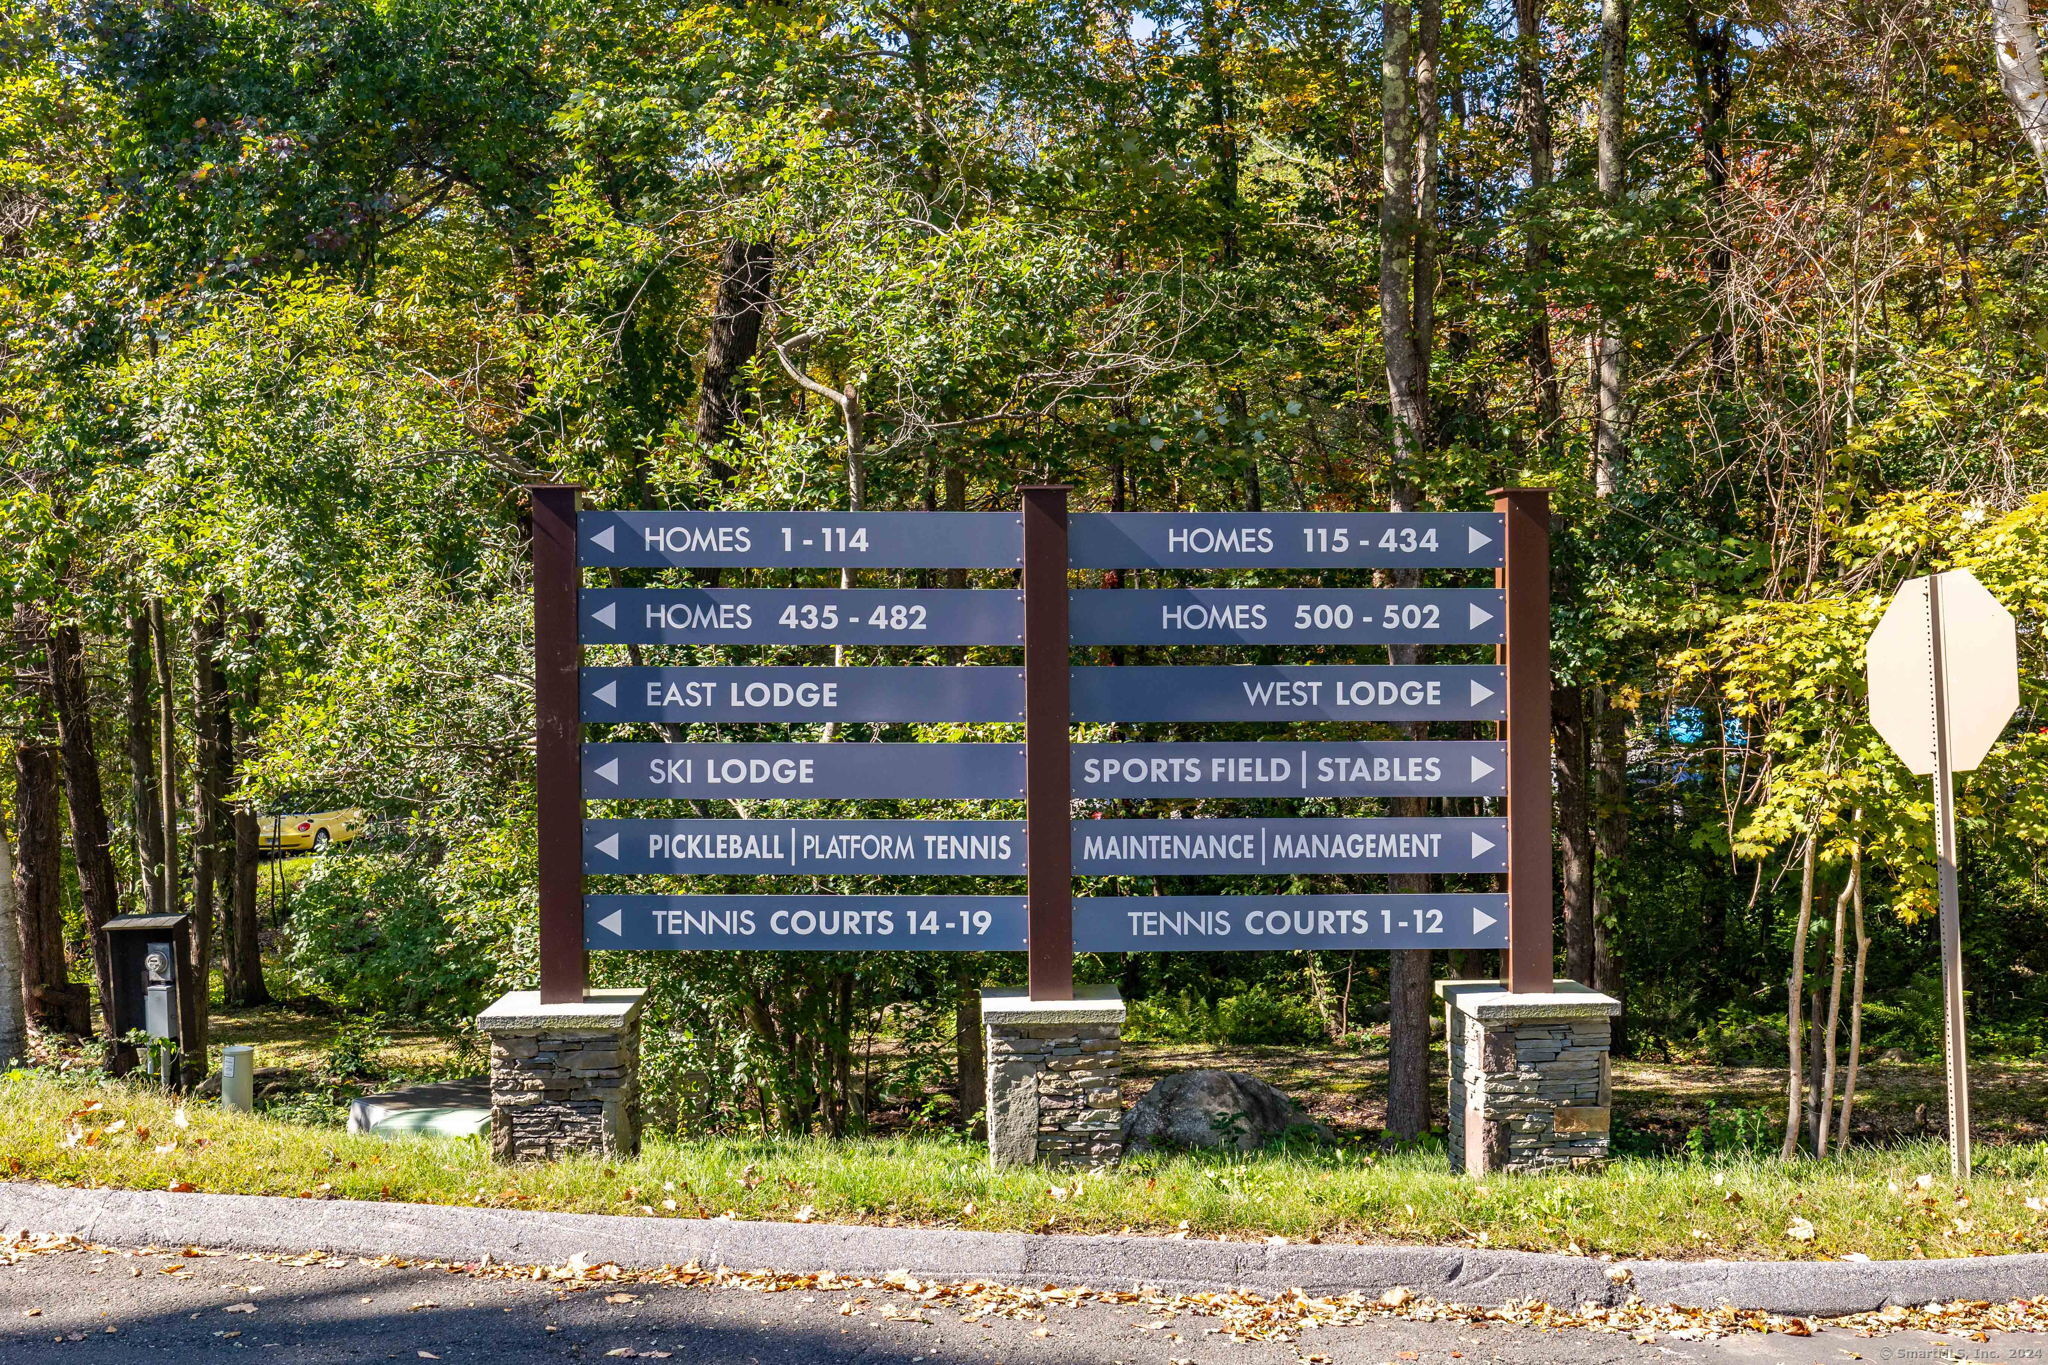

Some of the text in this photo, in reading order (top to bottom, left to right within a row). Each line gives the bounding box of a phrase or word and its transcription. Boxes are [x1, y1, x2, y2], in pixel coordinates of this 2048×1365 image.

[645, 527, 751, 552] HOMES
[782, 528, 791, 552] 1
[822, 528, 869, 552] 114
[1169, 528, 1273, 553] HOMES
[1304, 528, 1349, 552] 115
[1378, 528, 1438, 552] 434
[646, 604, 752, 629] HOMES
[779, 605, 838, 629] 435
[868, 605, 926, 629] 482
[1163, 605, 1267, 629] HOMES
[1294, 605, 1353, 629] 500
[1383, 605, 1439, 629] 502
[647, 682, 837, 707] EAST LODGE
[1243, 681, 1440, 706] WEST LODGE
[649, 759, 813, 783] SKI LODGE
[1084, 757, 1441, 783] SPORTS FIELD STABLES
[649, 834, 1011, 860] PICKLEBALL PLATFORM TENNIS
[1084, 834, 1441, 859] MAINTENANCE MANAGEMENT
[652, 910, 756, 935] TENNIS
[770, 910, 894, 935] COURTS
[1128, 911, 1230, 935] TENNIS
[1245, 910, 1368, 935] COURTS
